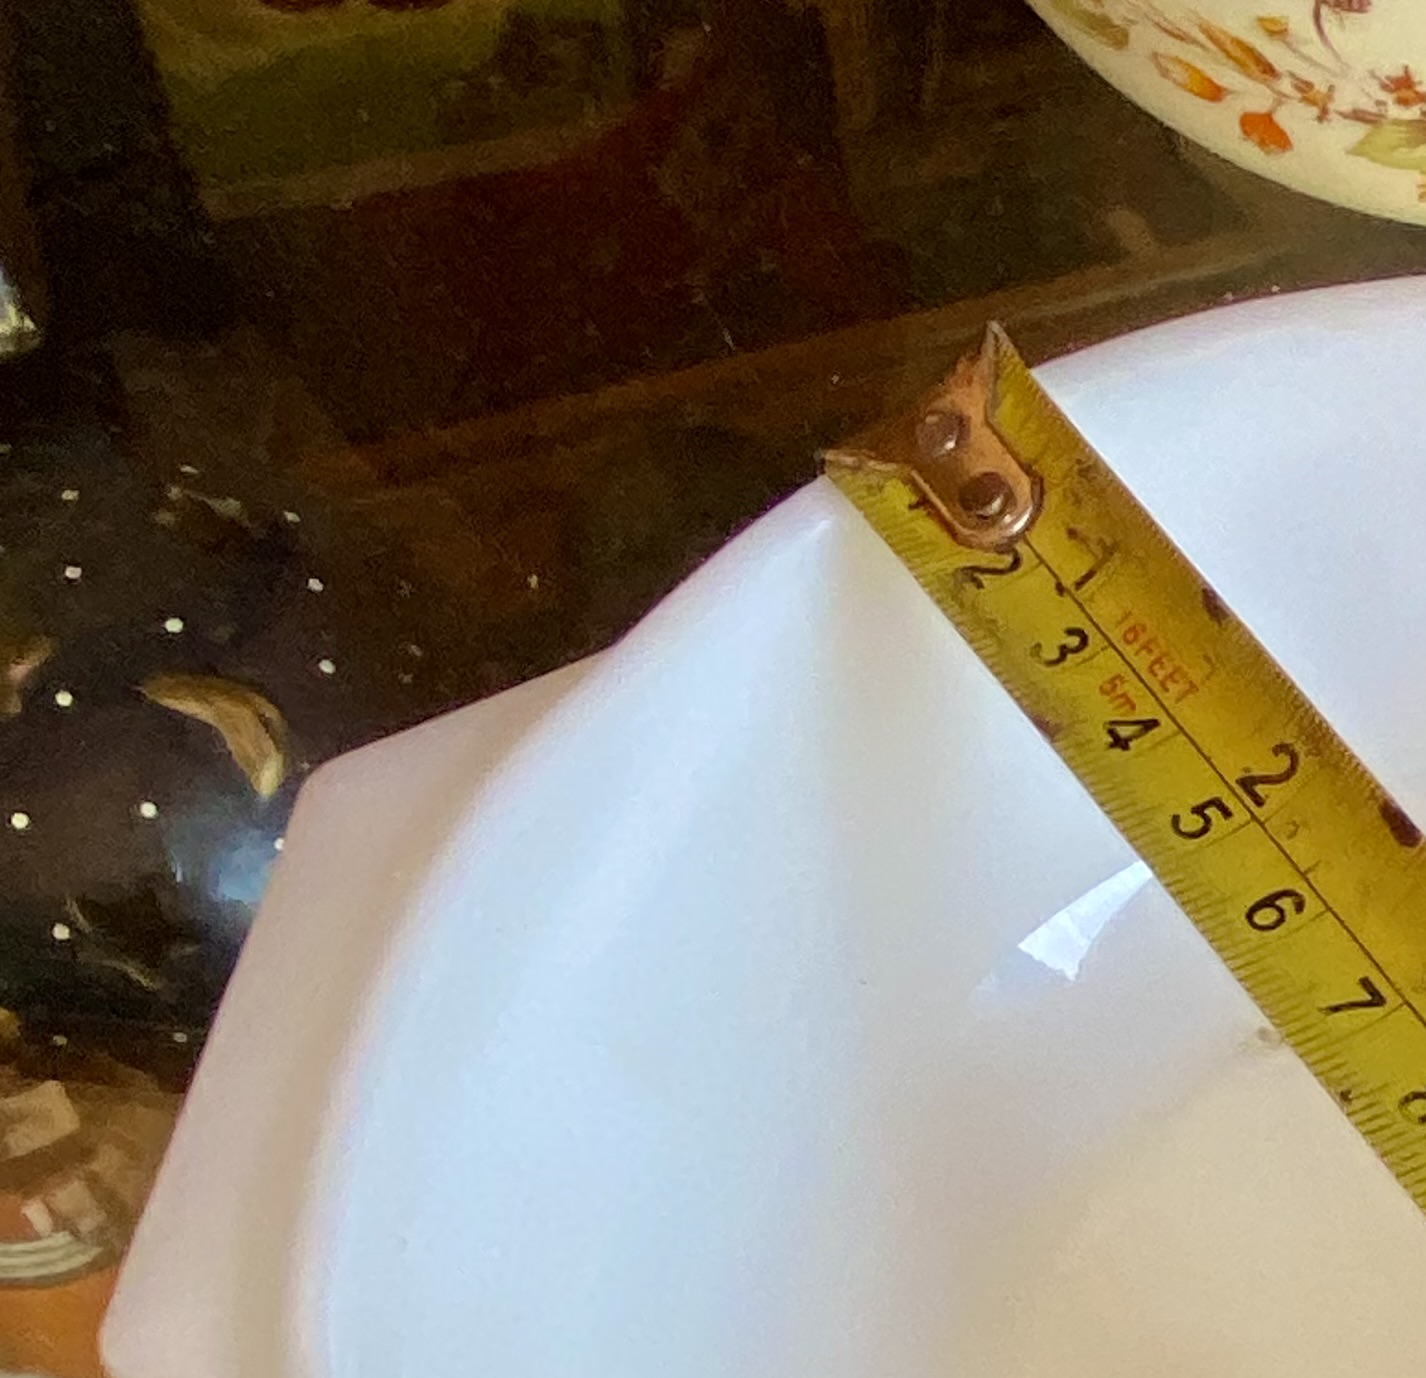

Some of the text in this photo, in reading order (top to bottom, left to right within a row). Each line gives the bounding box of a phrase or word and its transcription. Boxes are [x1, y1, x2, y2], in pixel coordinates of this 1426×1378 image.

[955, 547, 1021, 589] 2
[1030, 627, 1088, 667] 3
[1105, 718, 1160, 751] 4
[1171, 797, 1233, 839] 5
[1245, 889, 1306, 932] 6
[1319, 975, 1388, 1015] 7
[1236, 742, 1299, 806] 2
